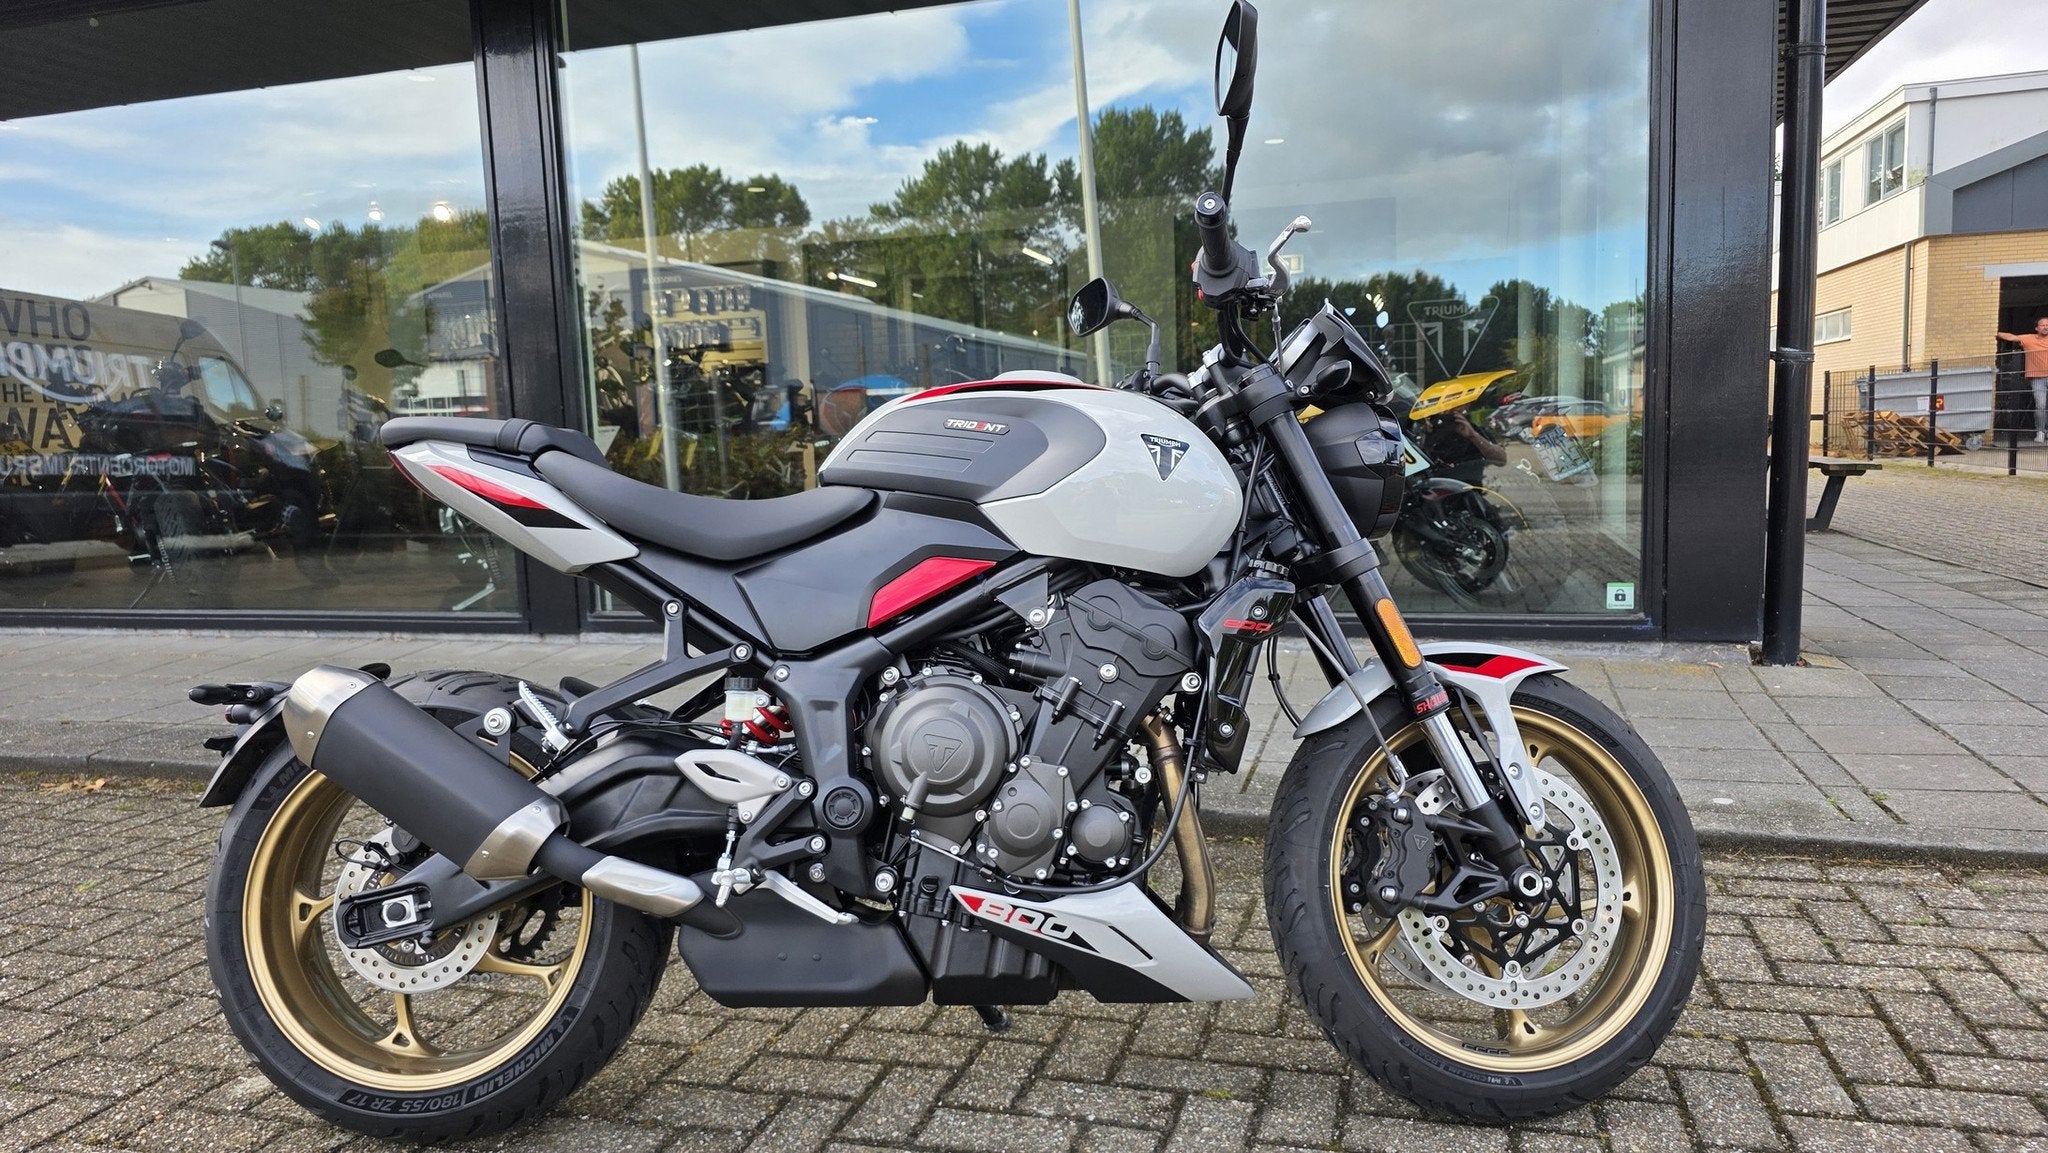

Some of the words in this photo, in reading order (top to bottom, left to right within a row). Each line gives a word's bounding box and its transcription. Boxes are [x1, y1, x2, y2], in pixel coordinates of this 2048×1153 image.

[947, 419, 1006, 433] TRIDENT
[1150, 436, 1181, 448] TRIUMPH
[1223, 619, 1274, 634] 800
[976, 897, 1075, 940] 800
[474, 1032, 555, 1098] MICHELIN
[346, 1092, 369, 1106] 17
[370, 1097, 397, 1112] ZR
[399, 1093, 460, 1112] 180/55
